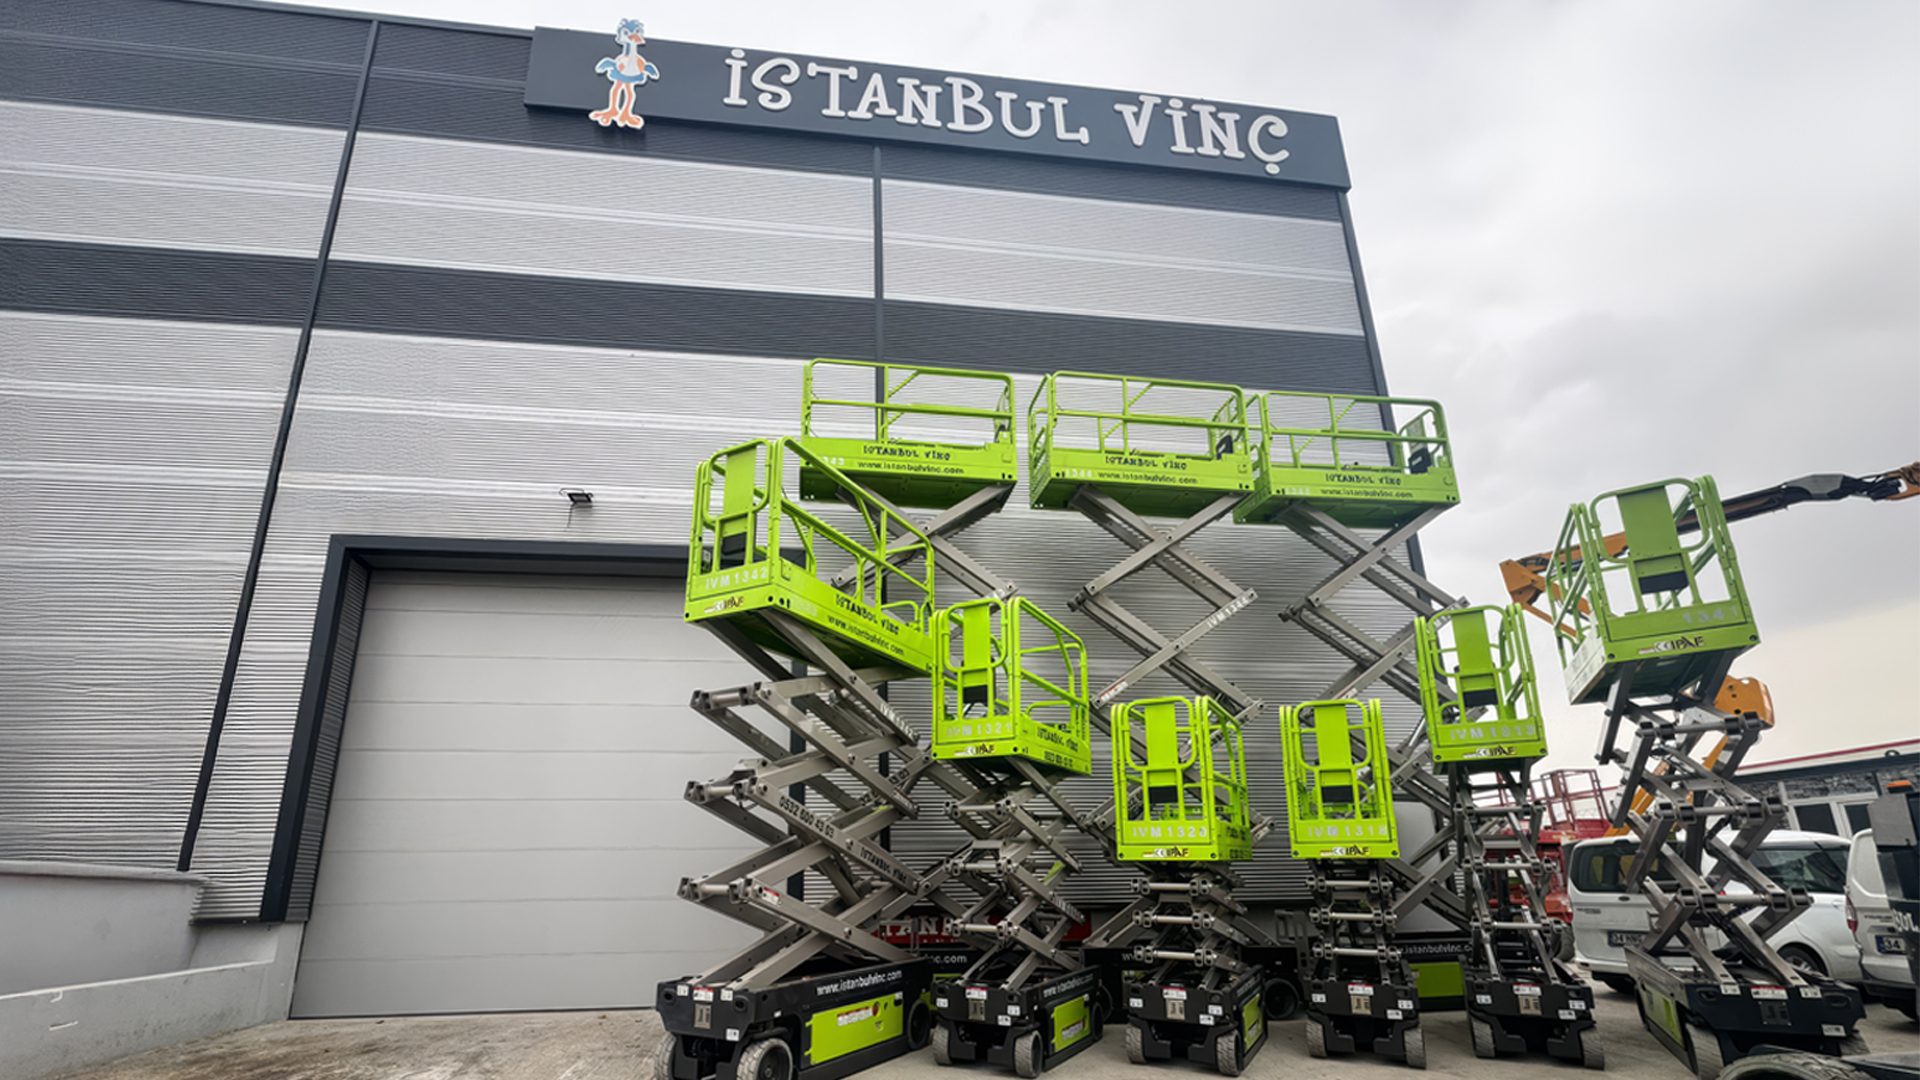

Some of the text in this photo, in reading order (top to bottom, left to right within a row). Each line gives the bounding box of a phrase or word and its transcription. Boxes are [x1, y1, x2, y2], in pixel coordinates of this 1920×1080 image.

[722, 48, 1290, 175] İSTANBUL VİNÇ
[857, 460, 965, 475] www.istanbulvinc.com
[734, 566, 768, 584] 1342
[1132, 827, 1162, 838] IVM
[816, 970, 903, 997] www.istanbulvinc.com
